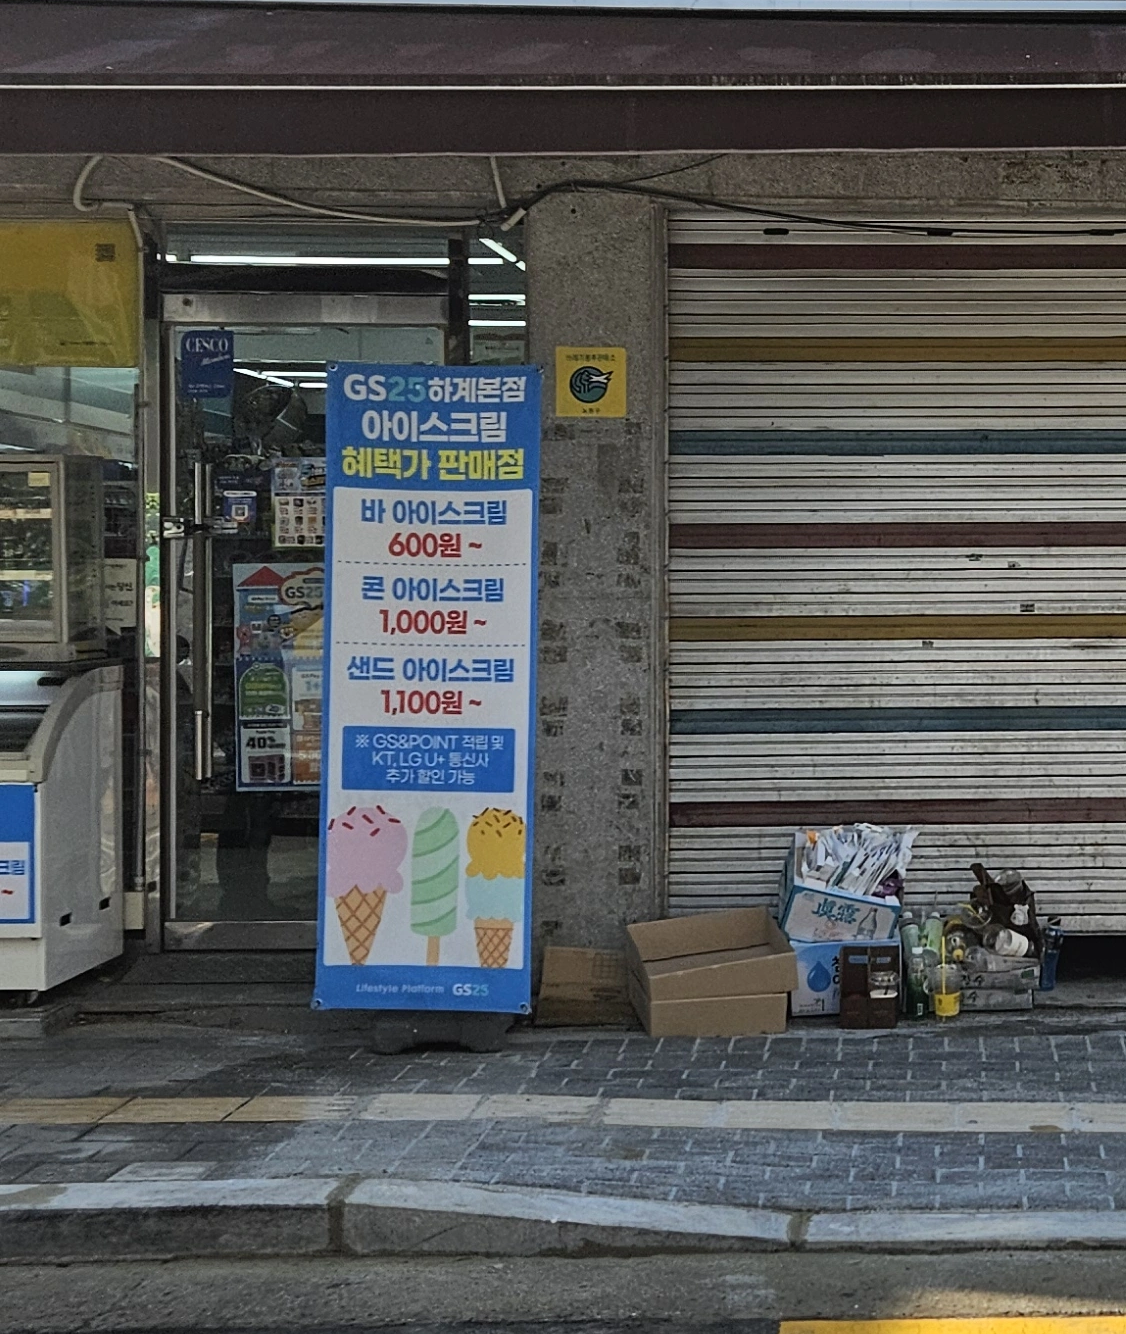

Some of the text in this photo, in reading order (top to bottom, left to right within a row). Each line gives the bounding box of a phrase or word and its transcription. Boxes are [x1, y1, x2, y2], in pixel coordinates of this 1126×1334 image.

[185, 337, 229, 353] CESCO
[361, 410, 508, 443] 아이스크림
[341, 446, 525, 481] 혜택가 판매점
[361, 498, 508, 526] 바 아이스크림
[361, 575, 505, 603] 콘 아이스크림
[347, 655, 515, 683] 샌드 아이스크림
[372, 733, 459, 750] GS&POINT
[462, 734, 489, 750] 적립
[491, 735, 504, 750] 및
[448, 751, 489, 768] 통신사
[386, 768, 476, 785] 추가 할인 가능
[452, 983, 489, 996] GS25
